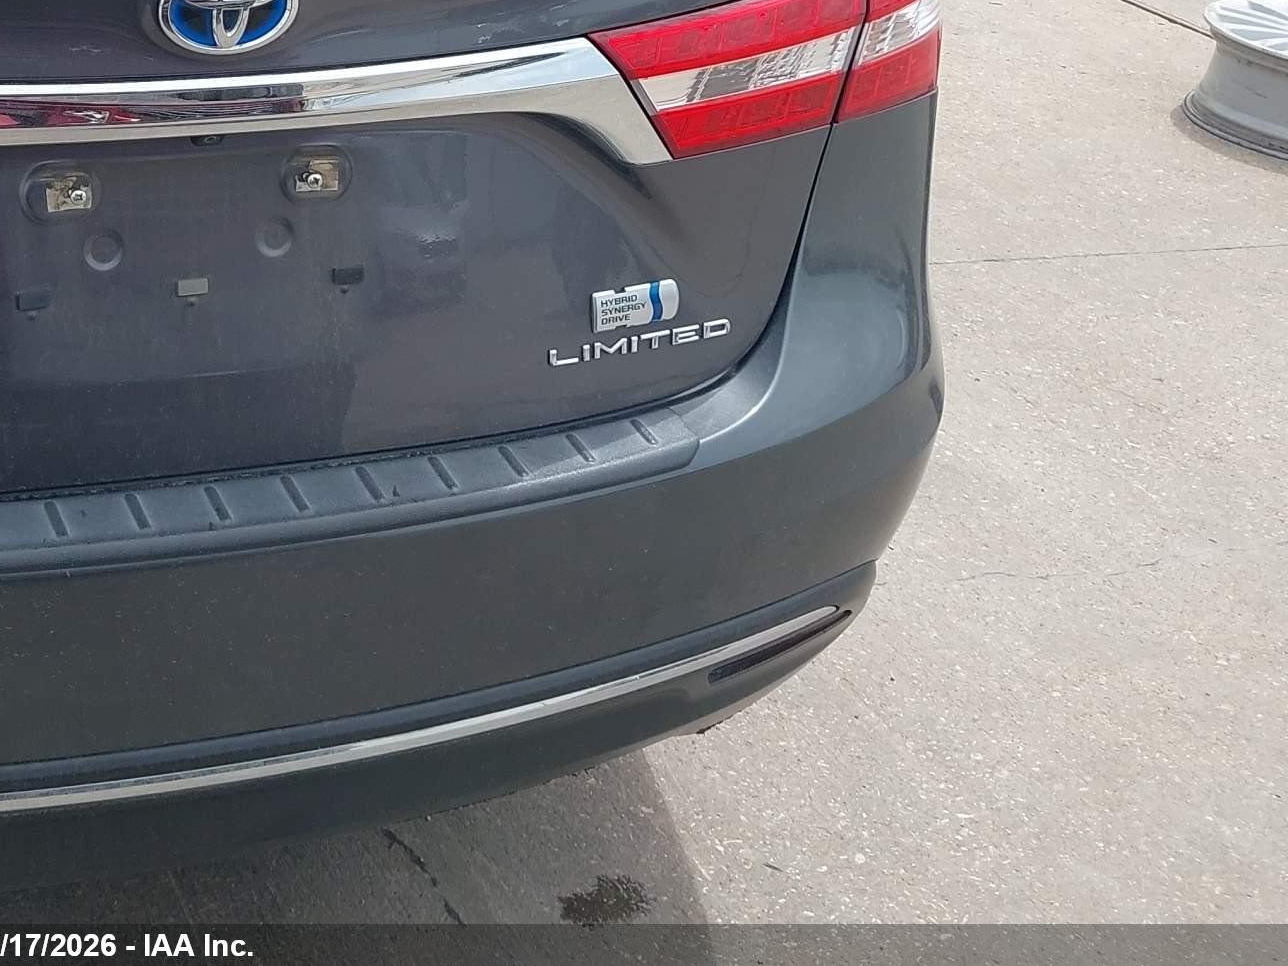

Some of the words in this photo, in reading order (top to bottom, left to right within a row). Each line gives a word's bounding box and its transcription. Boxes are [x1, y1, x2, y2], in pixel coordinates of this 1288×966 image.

[600, 294, 638, 308] HYBRID
[600, 301, 647, 317] SYNERGY
[600, 313, 631, 326] DRIVE
[548, 318, 731, 367] LIMITED
